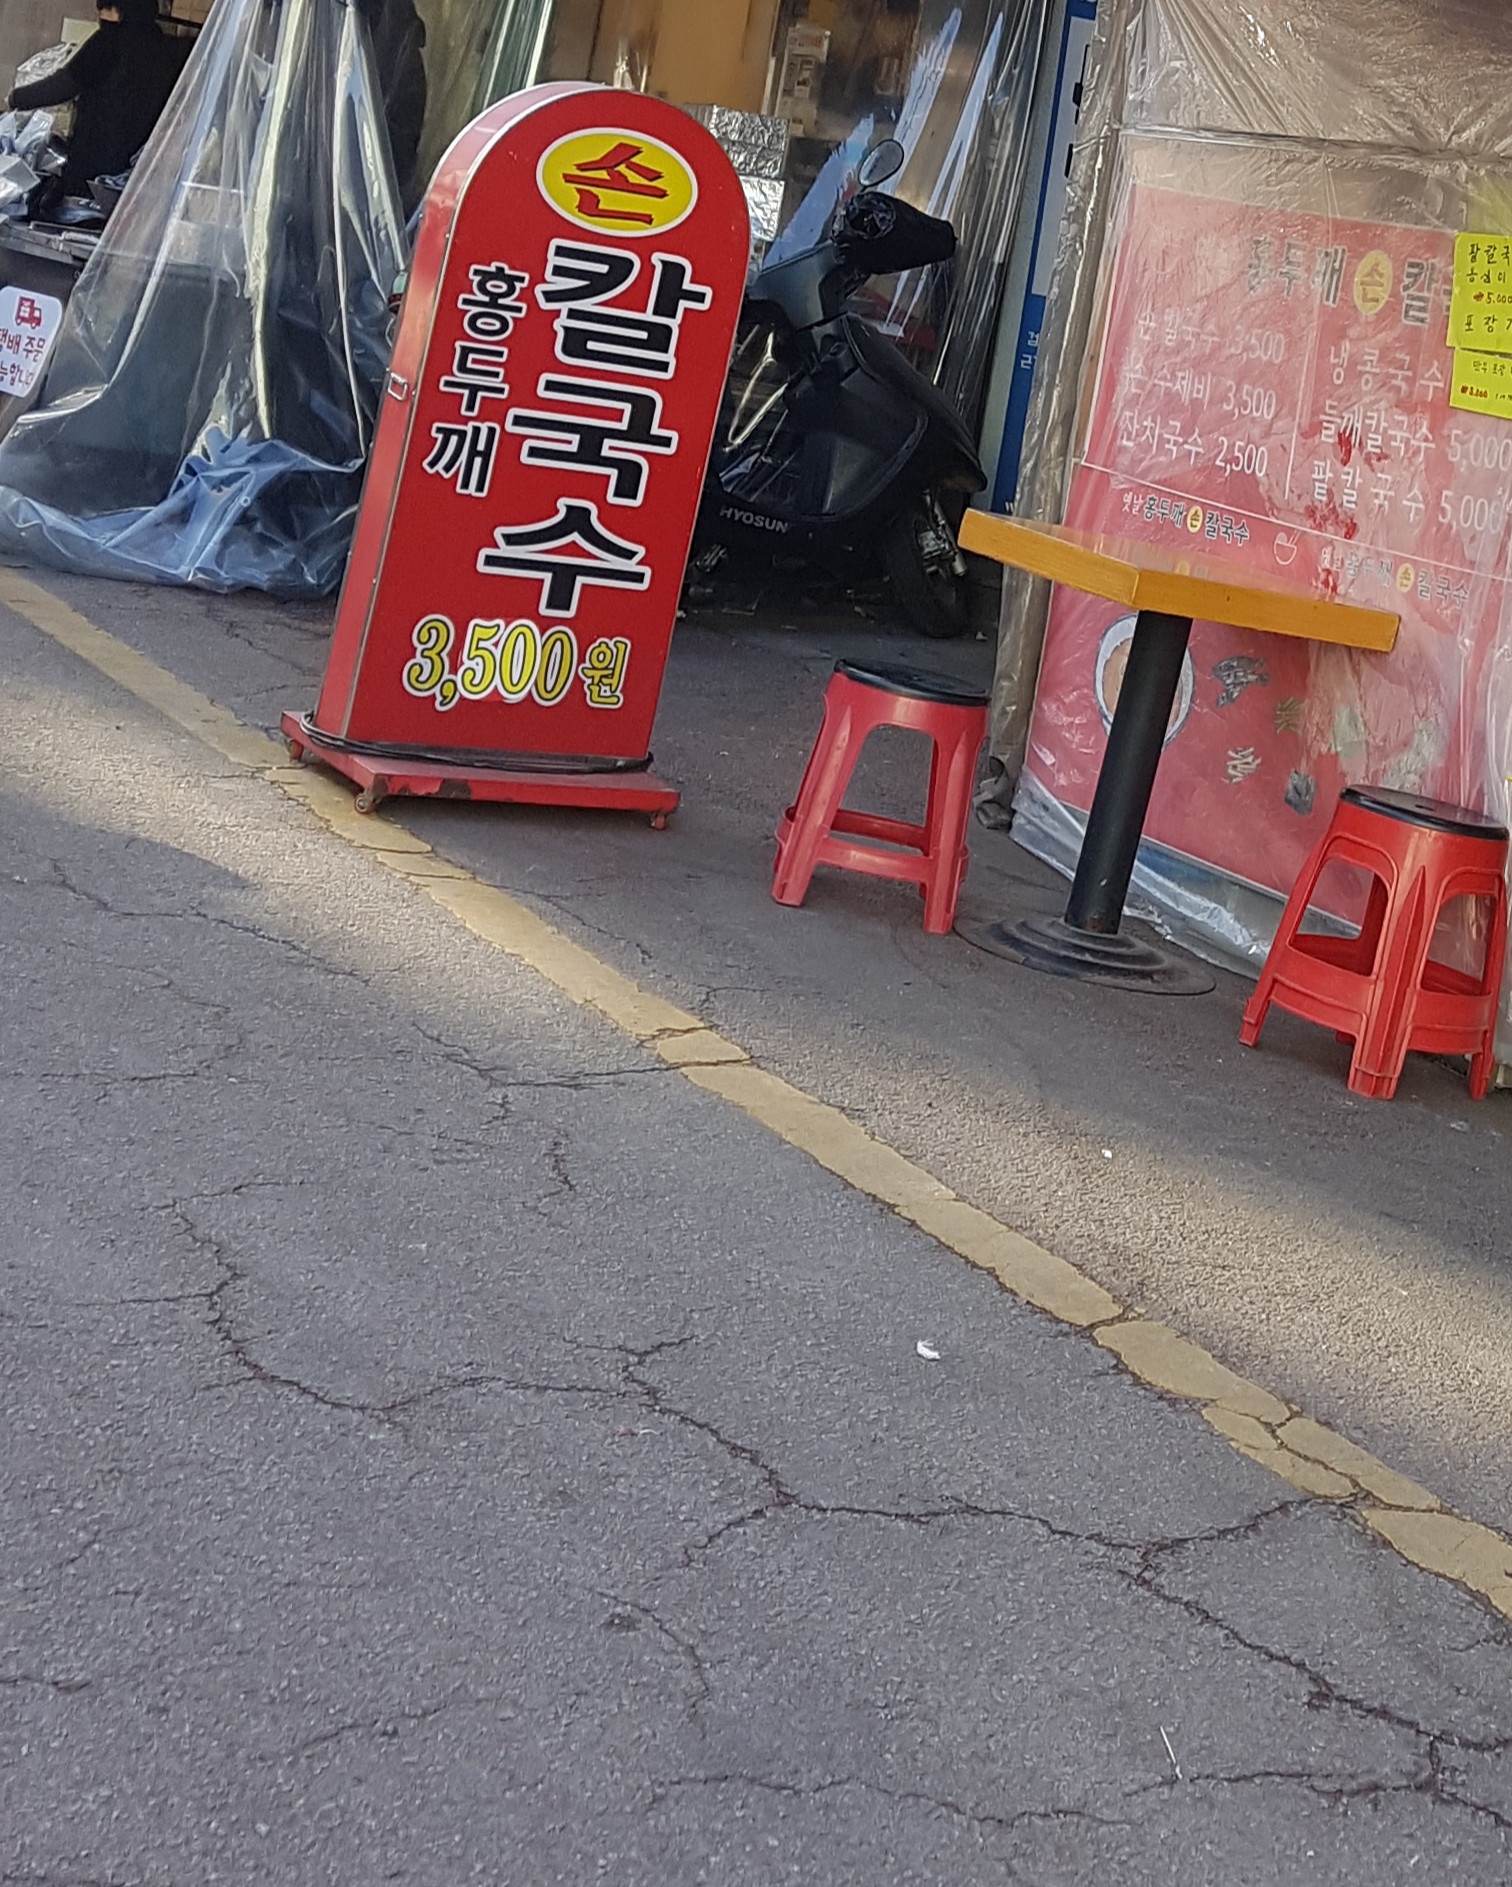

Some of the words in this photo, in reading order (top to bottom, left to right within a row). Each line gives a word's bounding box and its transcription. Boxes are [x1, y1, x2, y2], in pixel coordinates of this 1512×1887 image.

[562, 142, 669, 225] 손
[1360, 262, 1385, 303] 손
[423, 263, 530, 498] 홍두깨
[1153, 363, 1212, 410] 수제비
[1223, 381, 1275, 420] 3,500
[476, 238, 714, 616] 칼국수
[1119, 409, 1204, 466] 잔치국수
[1215, 436, 1268, 477] 2,500
[1320, 400, 1436, 463] 들깨칼국수
[1448, 429, 1512, 472] 5,000
[720, 505, 788, 533] HYOSUN
[1144, 495, 1185, 527] 홍두깨
[1205, 511, 1250, 546] 칼국수
[1416, 568, 1470, 606] 칼국수
